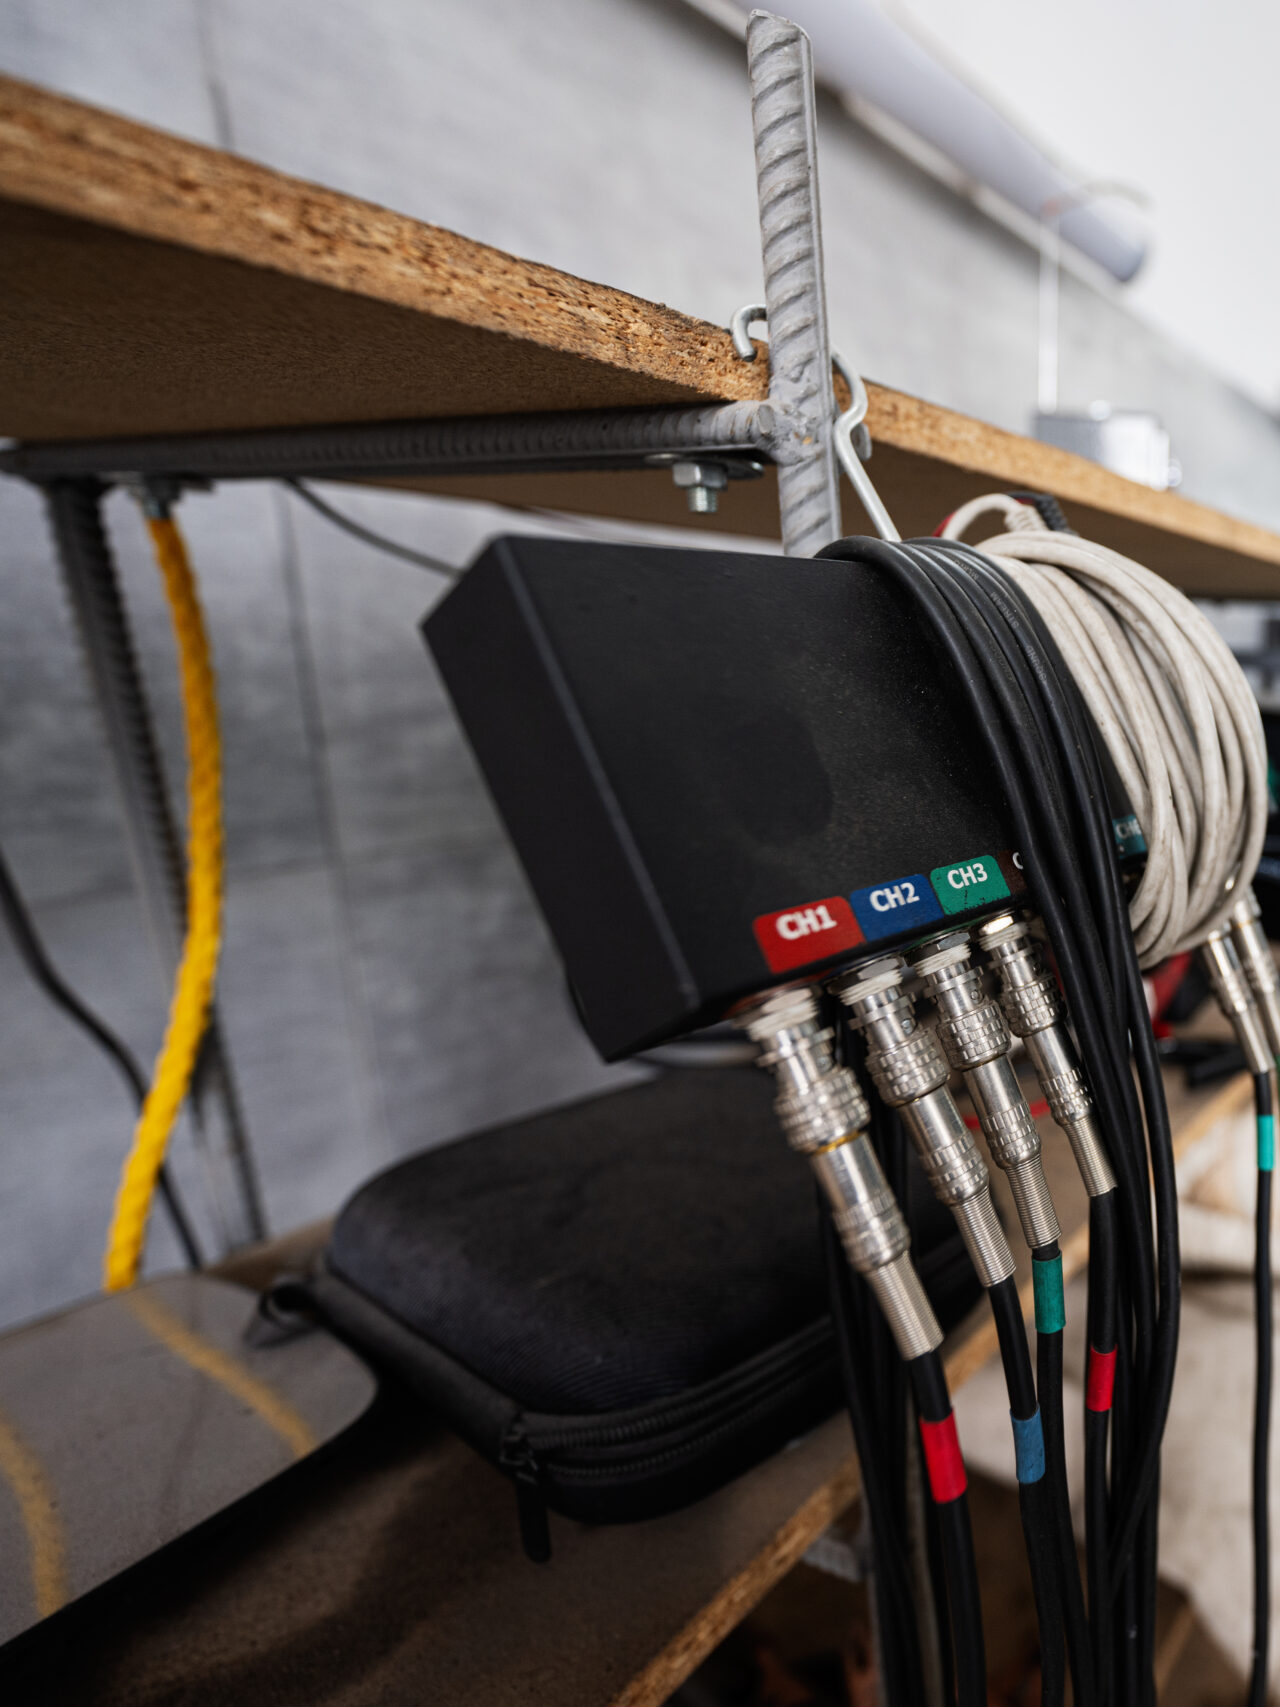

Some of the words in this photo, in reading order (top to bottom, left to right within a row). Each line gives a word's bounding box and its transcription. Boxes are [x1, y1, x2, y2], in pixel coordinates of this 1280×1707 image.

[990, 591, 1019, 629] STREAM
[947, 862, 988, 889] CH3
[869, 882, 920, 912] CH2
[776, 905, 837, 940] CH1
